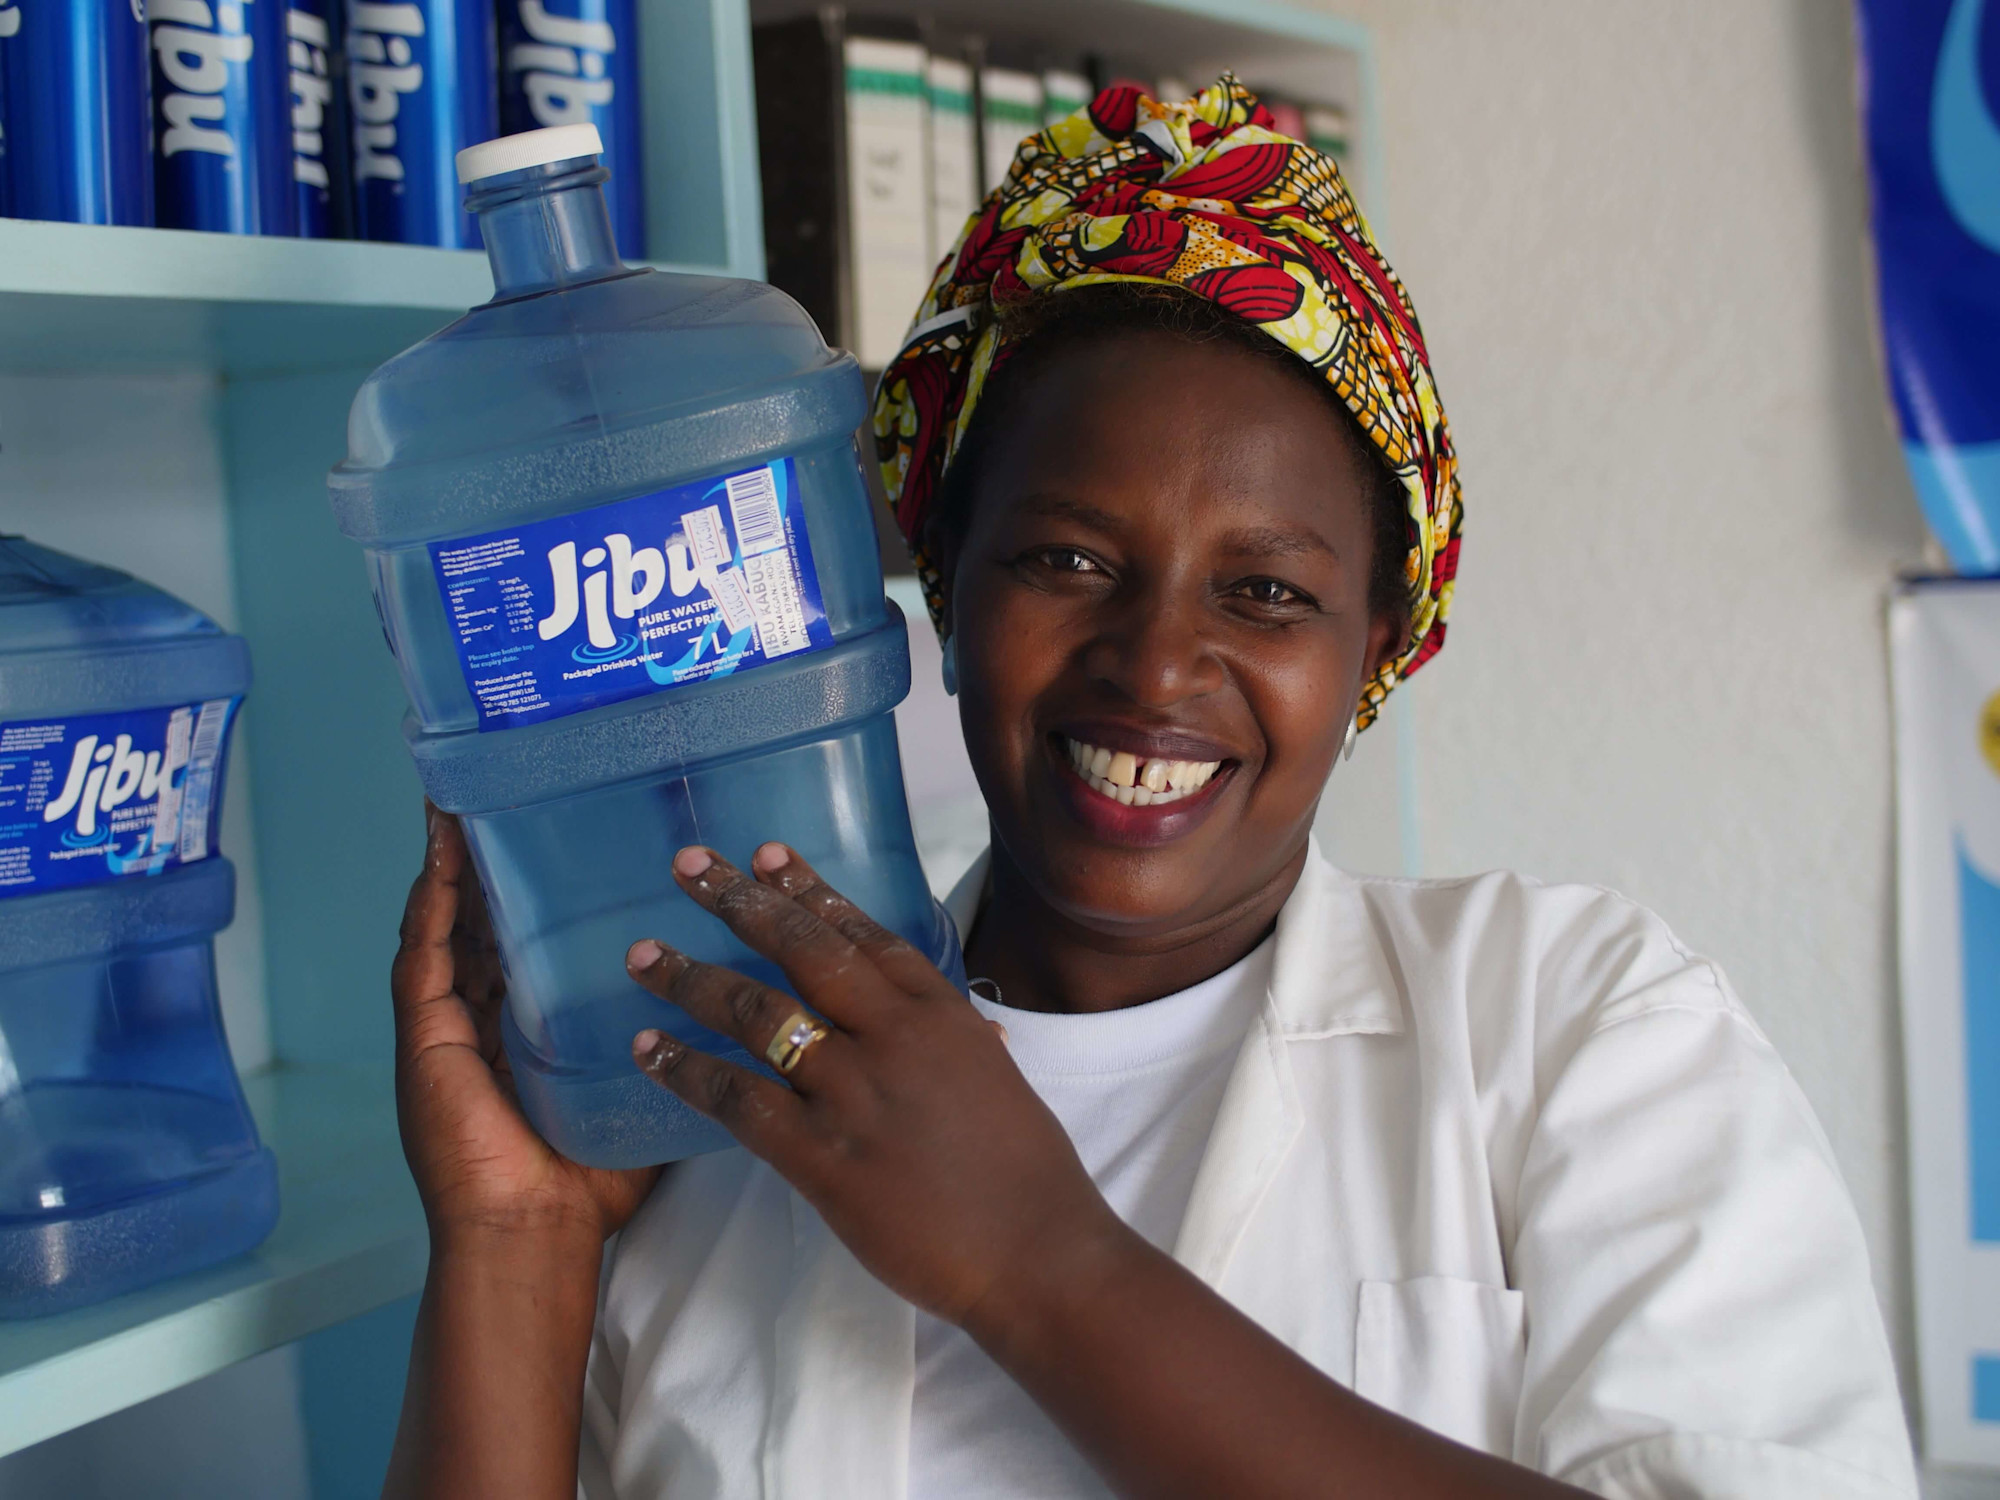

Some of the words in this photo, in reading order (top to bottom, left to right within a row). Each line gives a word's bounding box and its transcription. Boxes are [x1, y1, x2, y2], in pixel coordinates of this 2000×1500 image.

[150, 0, 253, 157] ibu
[508, 0, 615, 128] Jib
[538, 533, 720, 648] Jibu
[749, 557, 771, 615] KABUG
[638, 611, 671, 628] PURE
[641, 618, 693, 641] PERFECT
[694, 611, 724, 626] PRIC
[688, 636, 703, 660] 7
[712, 632, 728, 654] L
[475, 676, 504, 686] Produced
[504, 673, 521, 681] under
[563, 663, 601, 680] Packaged
[602, 657, 637, 672] Drinking
[638, 651, 663, 664] Water
[44, 734, 172, 836] Jibu
[110, 819, 144, 833] PERFECT
[112, 808, 133, 821] PURE
[134, 803, 157, 817] WATE
[137, 833, 148, 856] 7
